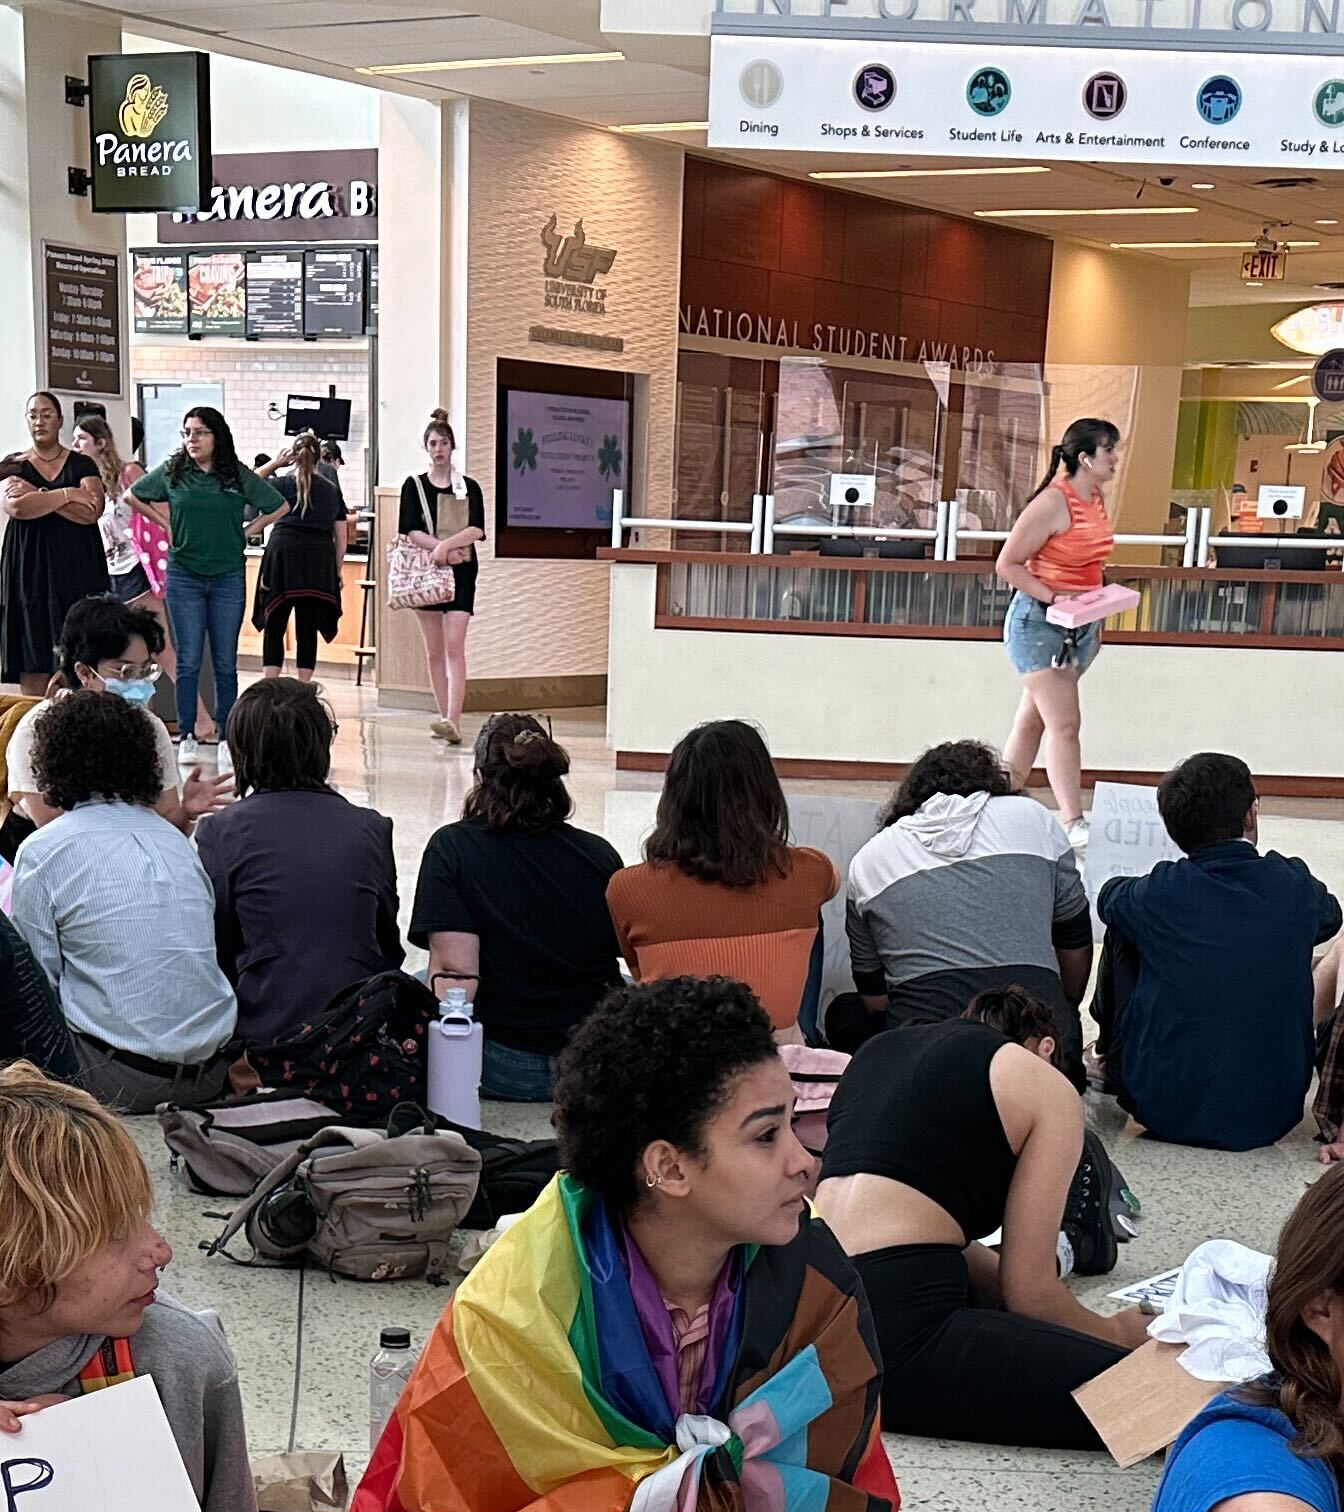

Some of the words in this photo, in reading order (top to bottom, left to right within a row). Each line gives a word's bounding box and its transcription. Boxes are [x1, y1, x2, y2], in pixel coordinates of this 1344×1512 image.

[739, 120, 779, 136] Dining
[821, 123, 858, 139] Shops
[861, 125, 870, 138] &
[874, 125, 924, 140] Services
[949, 128, 997, 142] Student
[1001, 129, 1023, 143] Life
[1036, 131, 1061, 145] Arts
[1065, 132, 1075, 145] &
[1078, 133, 1165, 148] Entertainment
[1179, 136, 1250, 151] Conference
[1280, 139, 1316, 155] Study
[1319, 141, 1329, 153] &
[95, 133, 192, 166] Panera
[116, 165, 172, 177] BREAD
[173, 182, 333, 223] anera
[1250, 255, 1278, 277] EXIT
[679, 304, 799, 349] NATIONAL
[813, 323, 908, 362] STUDENT
[917, 339, 995, 377] AWARDS
